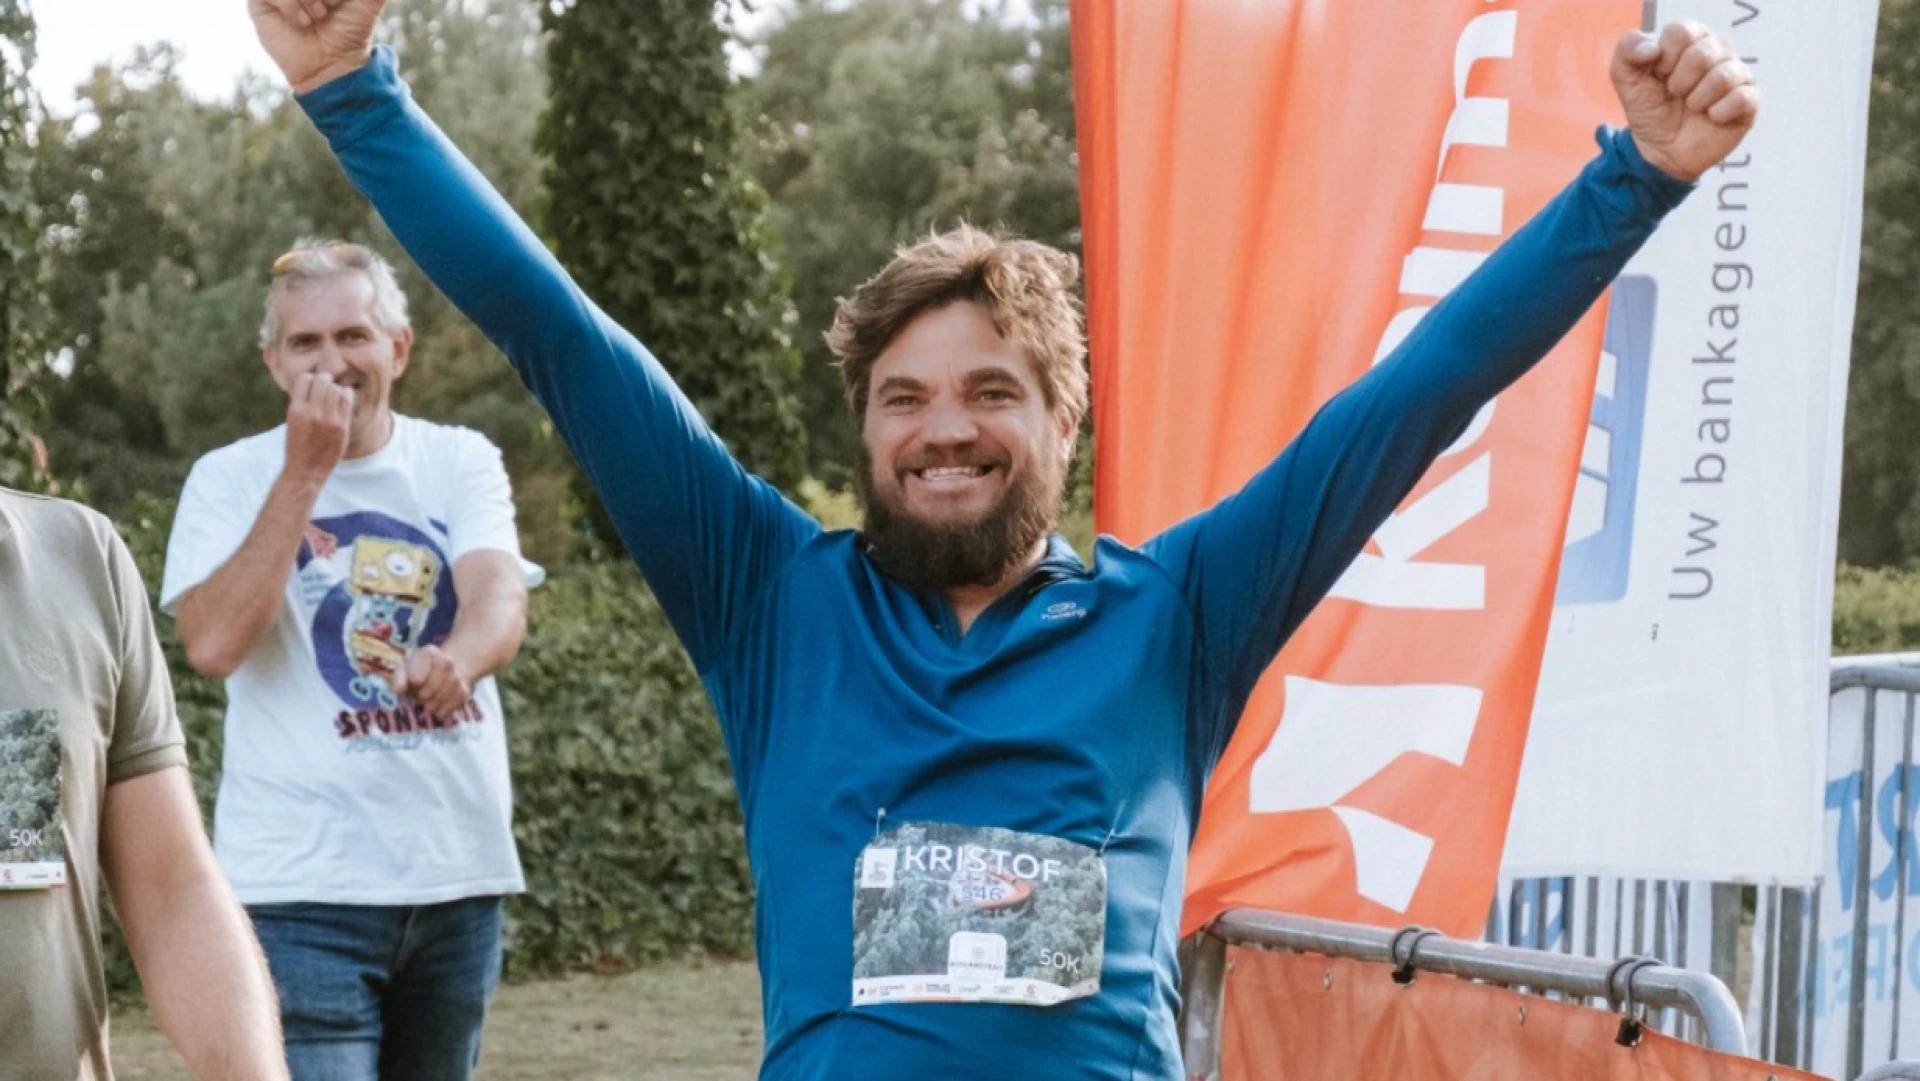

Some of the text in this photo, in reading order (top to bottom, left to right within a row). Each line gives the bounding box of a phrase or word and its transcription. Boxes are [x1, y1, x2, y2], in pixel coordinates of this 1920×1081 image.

[1681, 152, 1754, 485] bankagent
[1668, 512, 1720, 601] Uw
[9, 828, 44, 848] 50K
[904, 845, 1062, 883] KRISTOF
[1039, 949, 1081, 974] 50K
